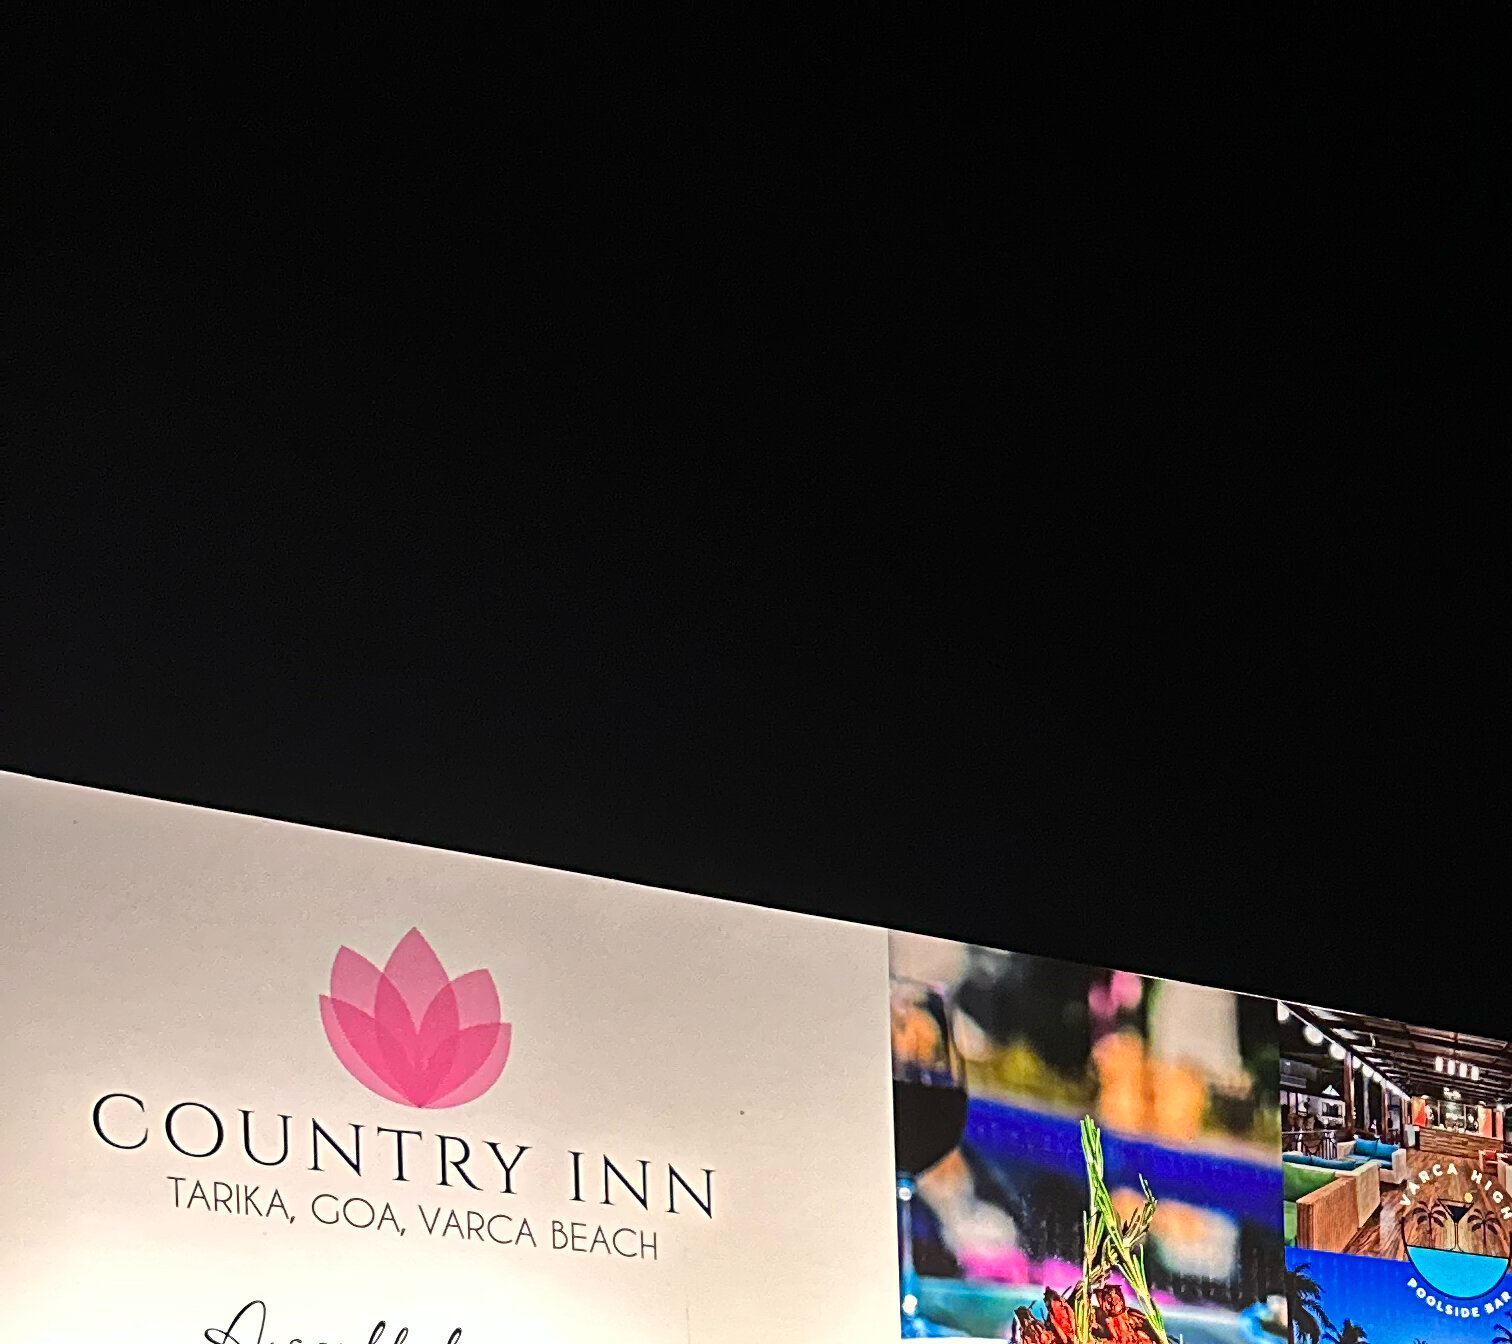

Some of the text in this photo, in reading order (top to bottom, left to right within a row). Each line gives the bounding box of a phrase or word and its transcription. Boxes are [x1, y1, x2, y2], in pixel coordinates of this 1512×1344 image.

[92, 1093, 717, 1220] COUNTRY INN
[1400, 1163, 1512, 1220] VARCA HIGH
[165, 1175, 658, 1261] TARIKA, GOA, VARCA BEACH
[1407, 1277, 1512, 1318] POOLSIDE BAR
